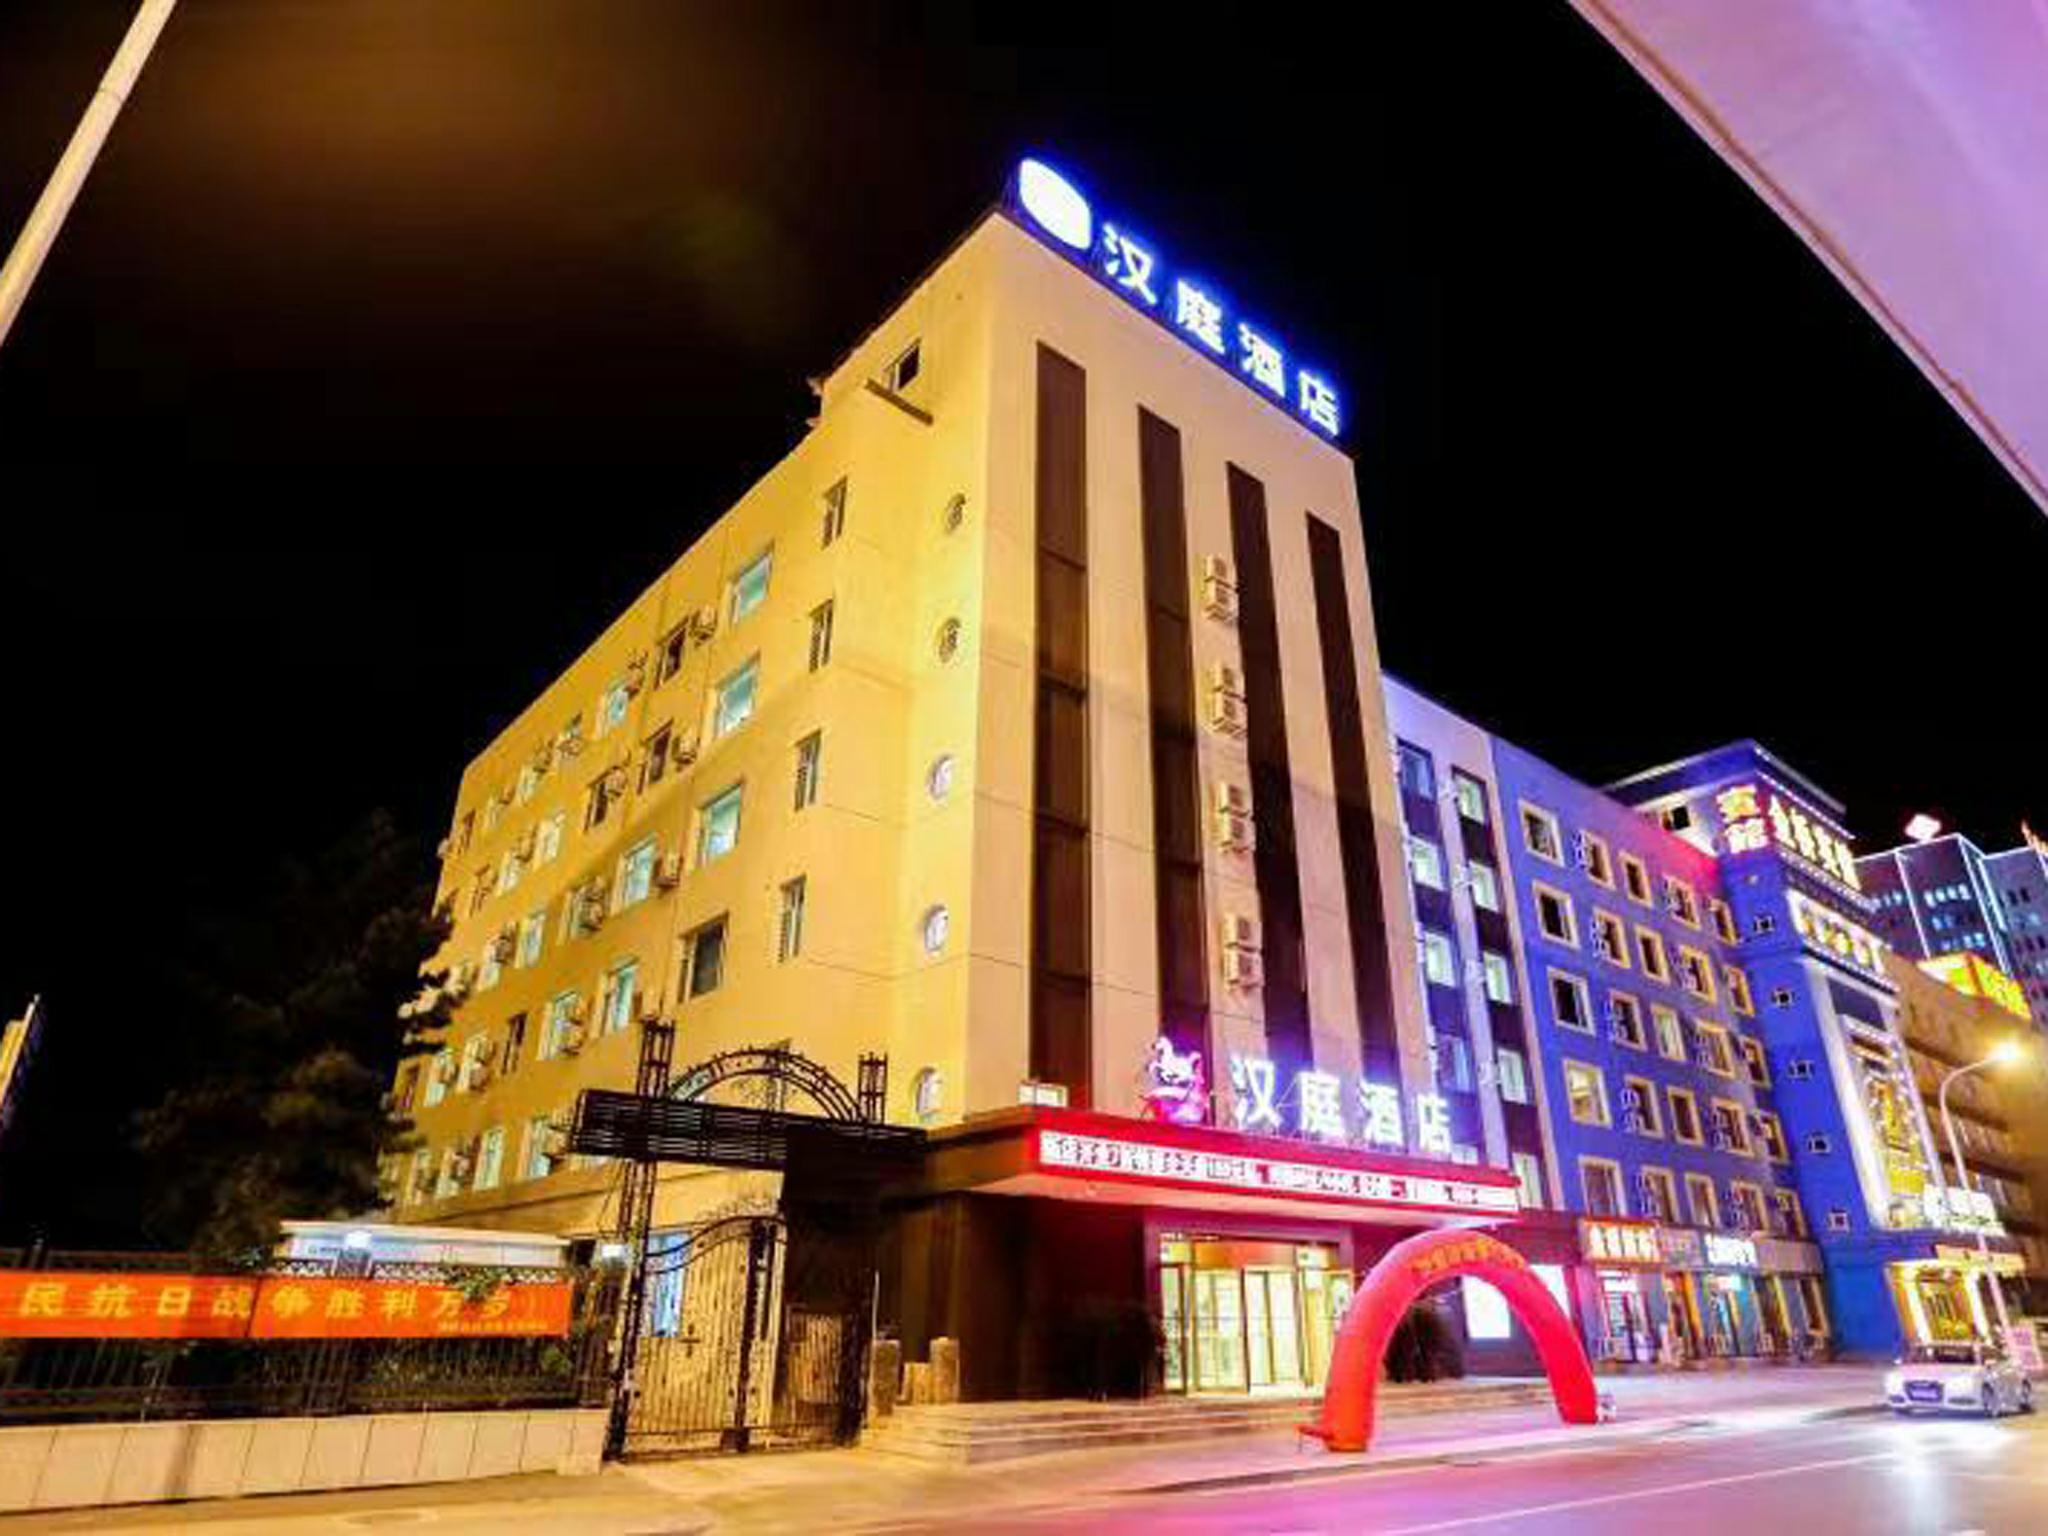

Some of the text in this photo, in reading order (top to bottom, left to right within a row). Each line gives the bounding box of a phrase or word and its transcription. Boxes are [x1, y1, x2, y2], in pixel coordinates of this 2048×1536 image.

[1102, 222, 1340, 437] 汉庭酒店
[1232, 1055, 1452, 1154] 汉庭酒店
